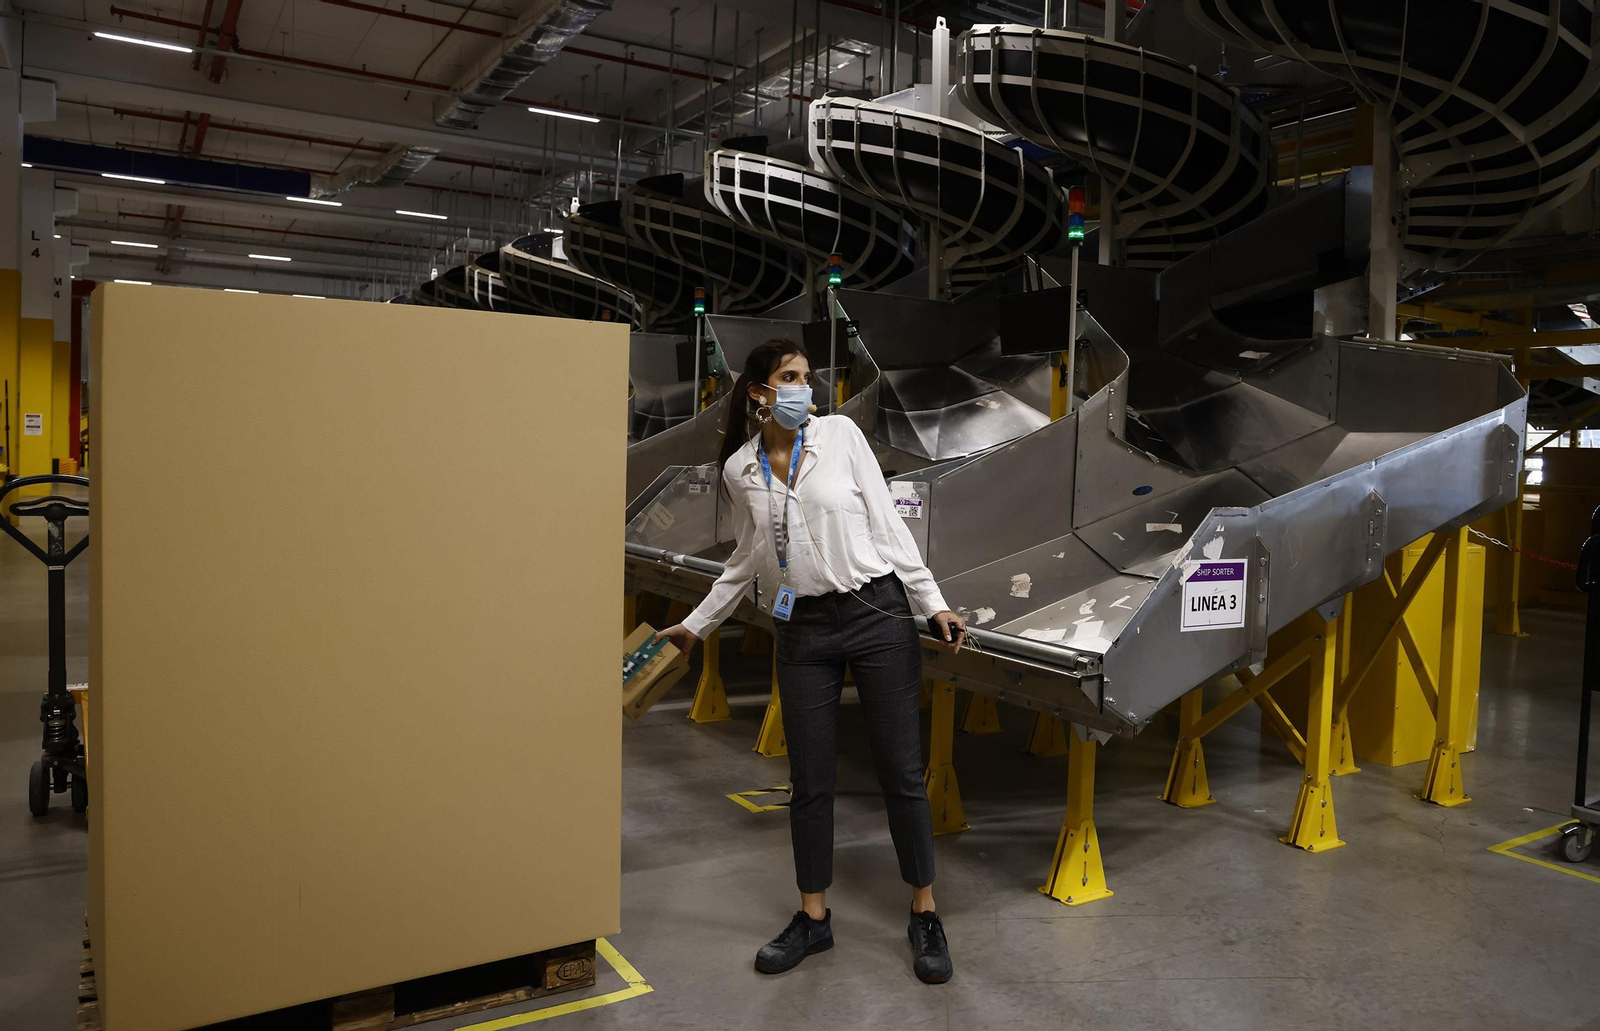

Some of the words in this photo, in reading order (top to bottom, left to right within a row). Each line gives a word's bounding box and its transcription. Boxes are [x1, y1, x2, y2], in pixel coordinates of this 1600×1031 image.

[31, 230, 40, 241] L
[31, 247, 40, 258] 4
[53, 290, 61, 299] 4
[1196, 568, 1211, 577] SHIP
[1212, 567, 1235, 576] SORTER
[1191, 595, 1226, 612] LINEA
[1229, 594, 1237, 610] 3
[563, 960, 588, 978] EPAL
